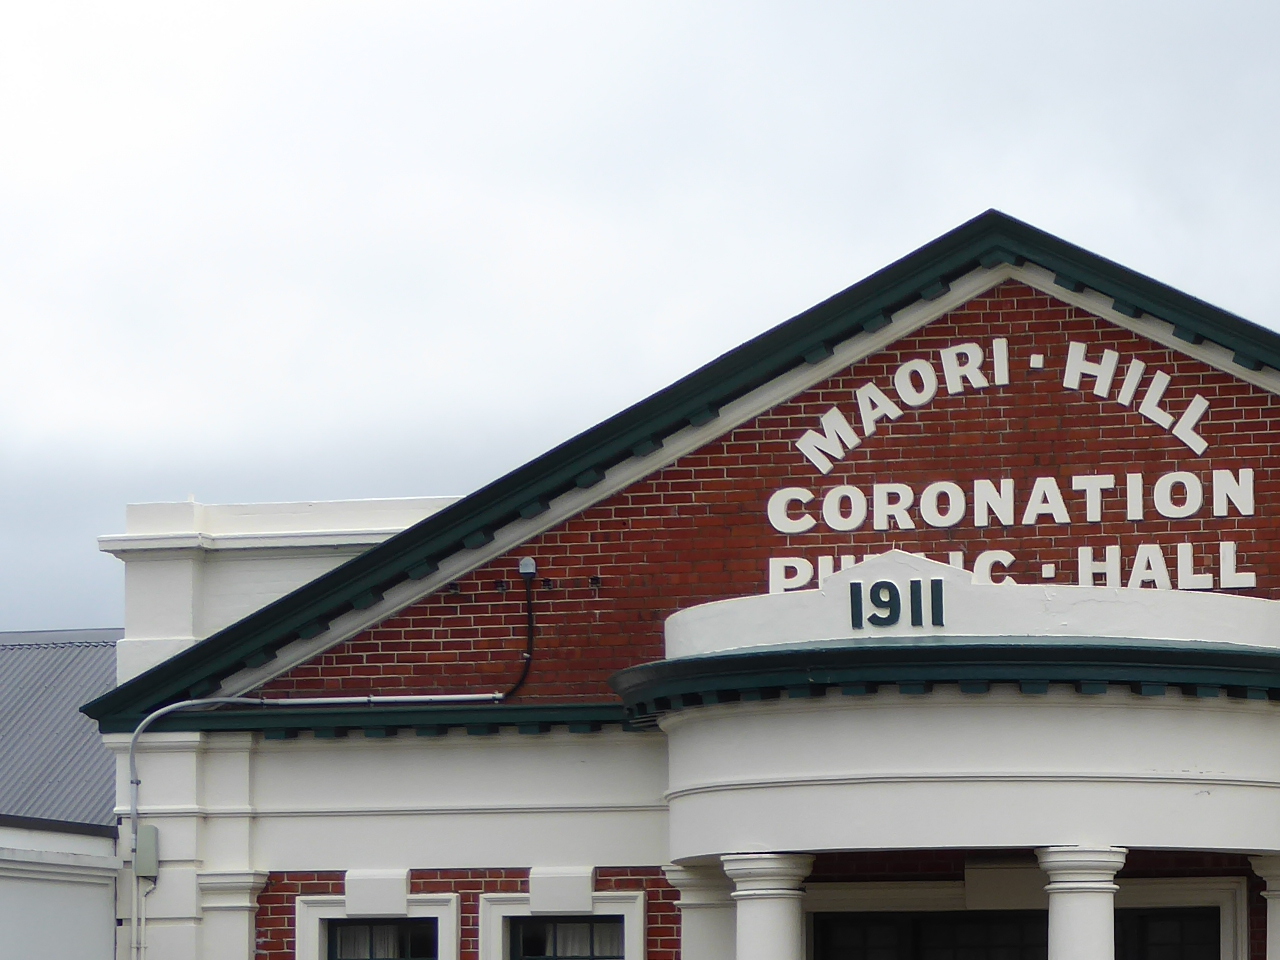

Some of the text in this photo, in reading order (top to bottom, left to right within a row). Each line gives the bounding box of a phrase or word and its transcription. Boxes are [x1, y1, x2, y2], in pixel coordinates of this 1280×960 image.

[795, 337, 1210, 475] MAORI HILL
[766, 467, 1256, 534] CORONATION
[1078, 540, 1257, 590] HALL
[850, 578, 945, 630] 1911
